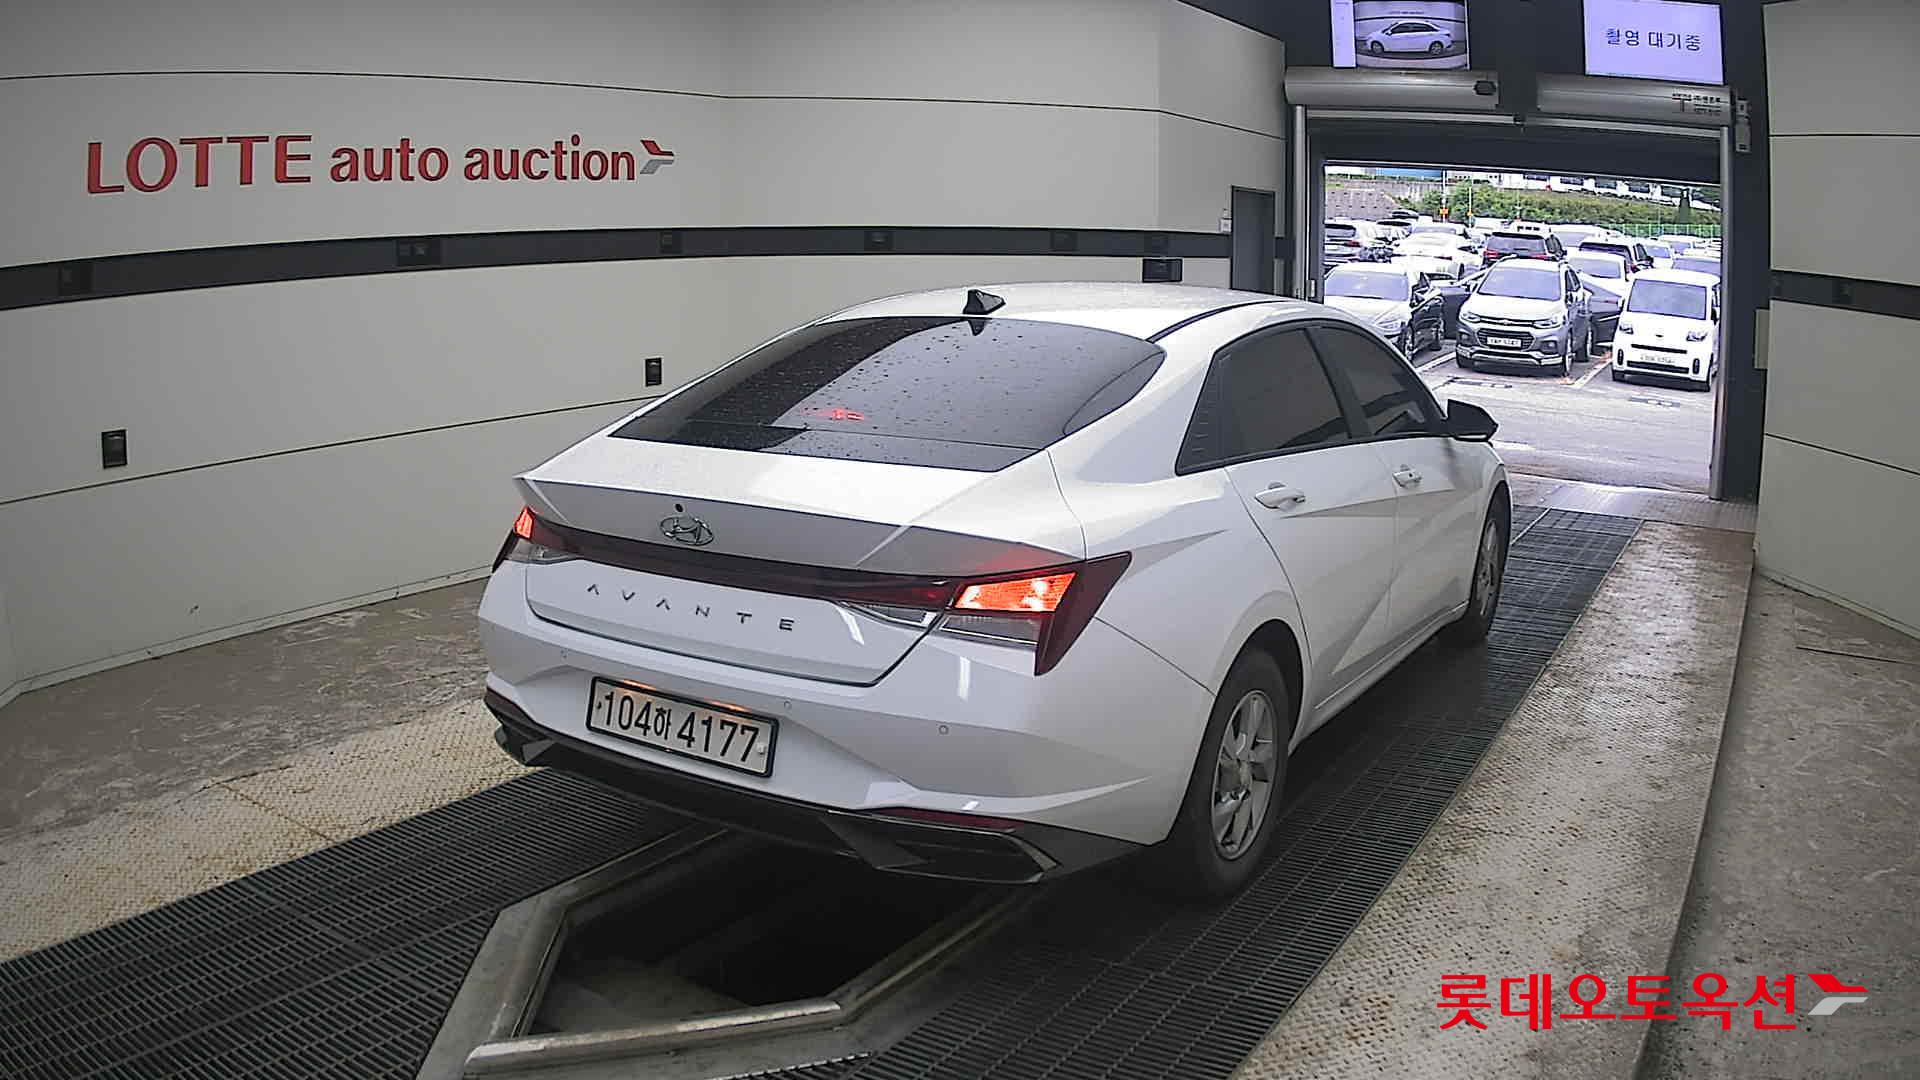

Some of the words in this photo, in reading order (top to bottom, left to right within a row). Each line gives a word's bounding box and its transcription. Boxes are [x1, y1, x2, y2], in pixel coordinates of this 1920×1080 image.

[1606, 28, 1640, 47] 촬영
[1648, 31, 1701, 51] 대기중
[87, 135, 312, 194] LOTTE
[329, 137, 449, 182] auto
[463, 133, 636, 182] auction
[587, 583, 795, 631] AVANTE
[604, 690, 671, 740] 104하
[677, 711, 760, 763] 4177
